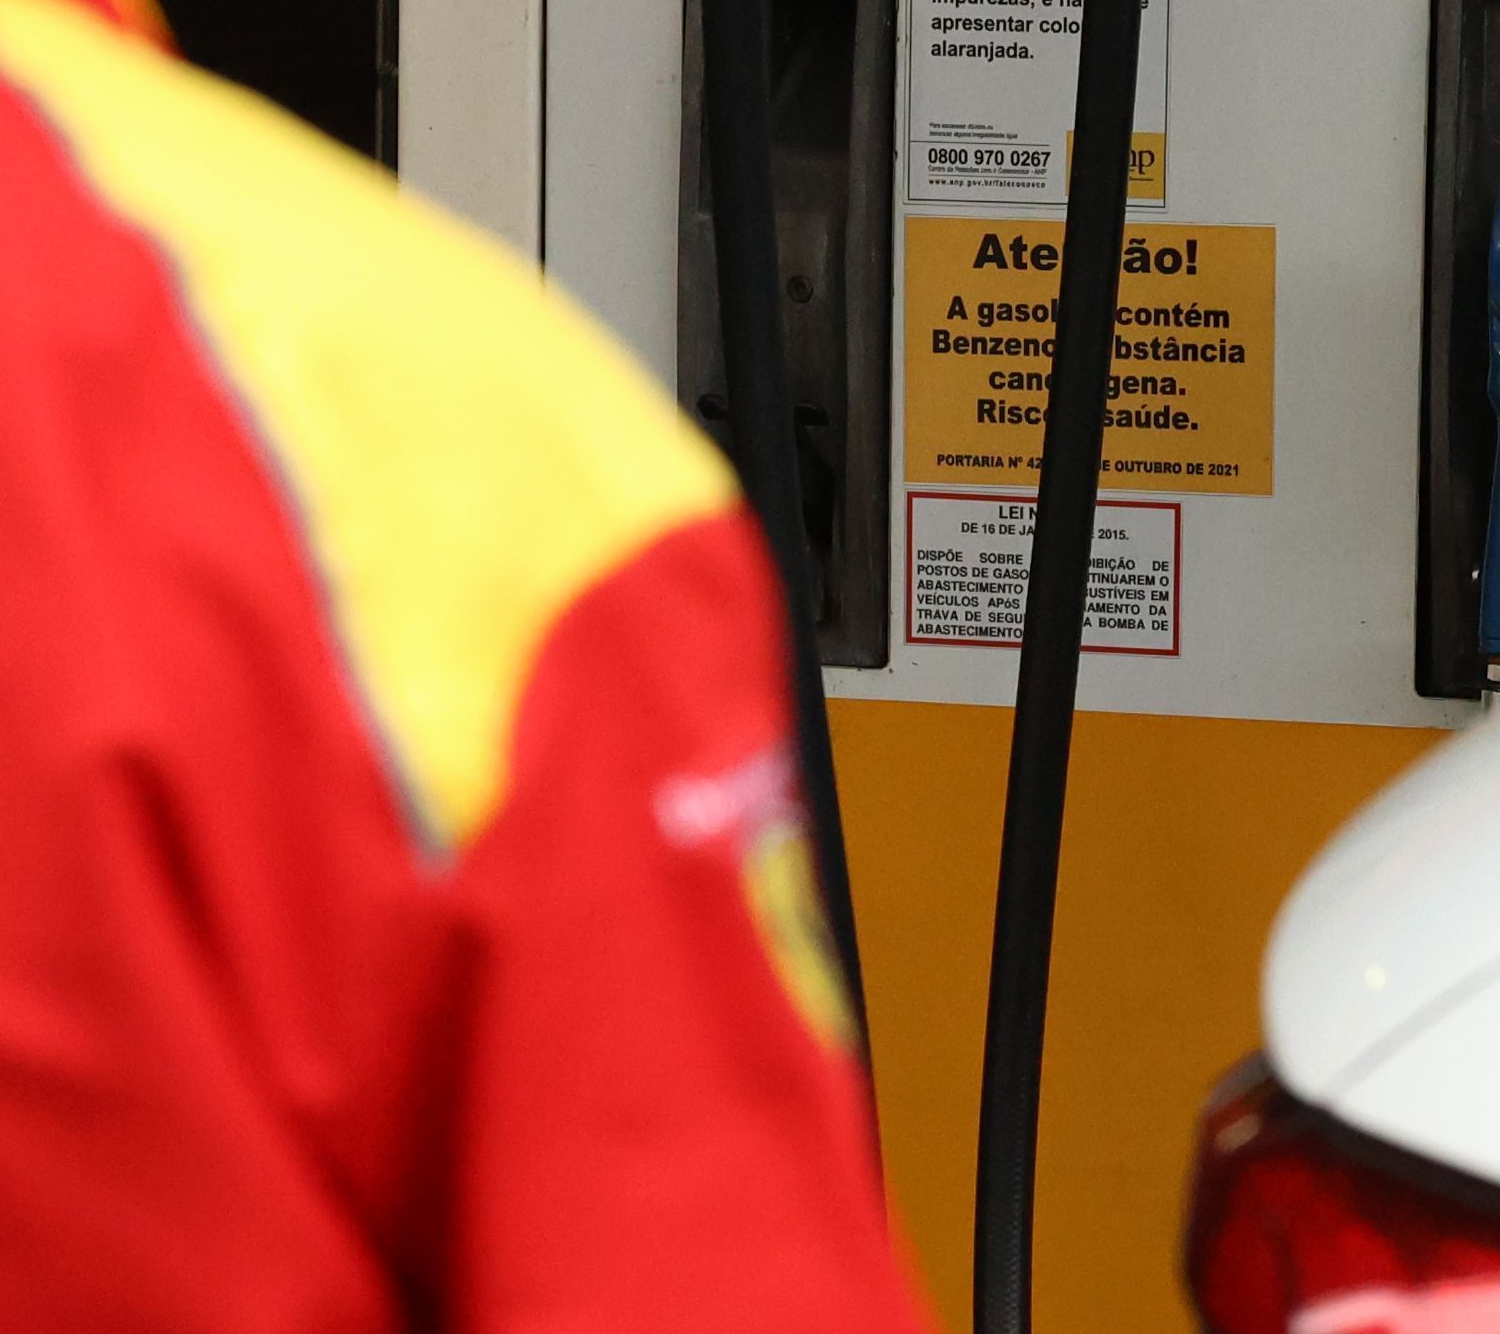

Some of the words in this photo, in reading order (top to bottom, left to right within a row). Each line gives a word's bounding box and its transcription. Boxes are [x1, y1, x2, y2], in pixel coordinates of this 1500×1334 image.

[931, 16, 1033, 37] apresentar
[931, 42, 1034, 63] alaranjada.
[928, 147, 968, 165] 0800
[974, 149, 1004, 166] 970
[1010, 150, 1051, 168] 0267
[972, 233, 1198, 276] Ateão!
[947, 295, 968, 320] A
[1116, 303, 1230, 329] contém
[1115, 336, 1246, 364] bstância
[1103, 404, 1198, 431] saúde.
[937, 454, 1003, 469] PORTARIA
[1115, 459, 1181, 475] OUTUBRO
[1186, 462, 1204, 475] DE
[1208, 463, 1239, 477] 2021
[979, 553, 1023, 565] SOBRE
[917, 565, 968, 577] POSTOS
[917, 580, 1023, 594] ABASTECIMENTO
[1098, 618, 1145, 630] BOMBA
